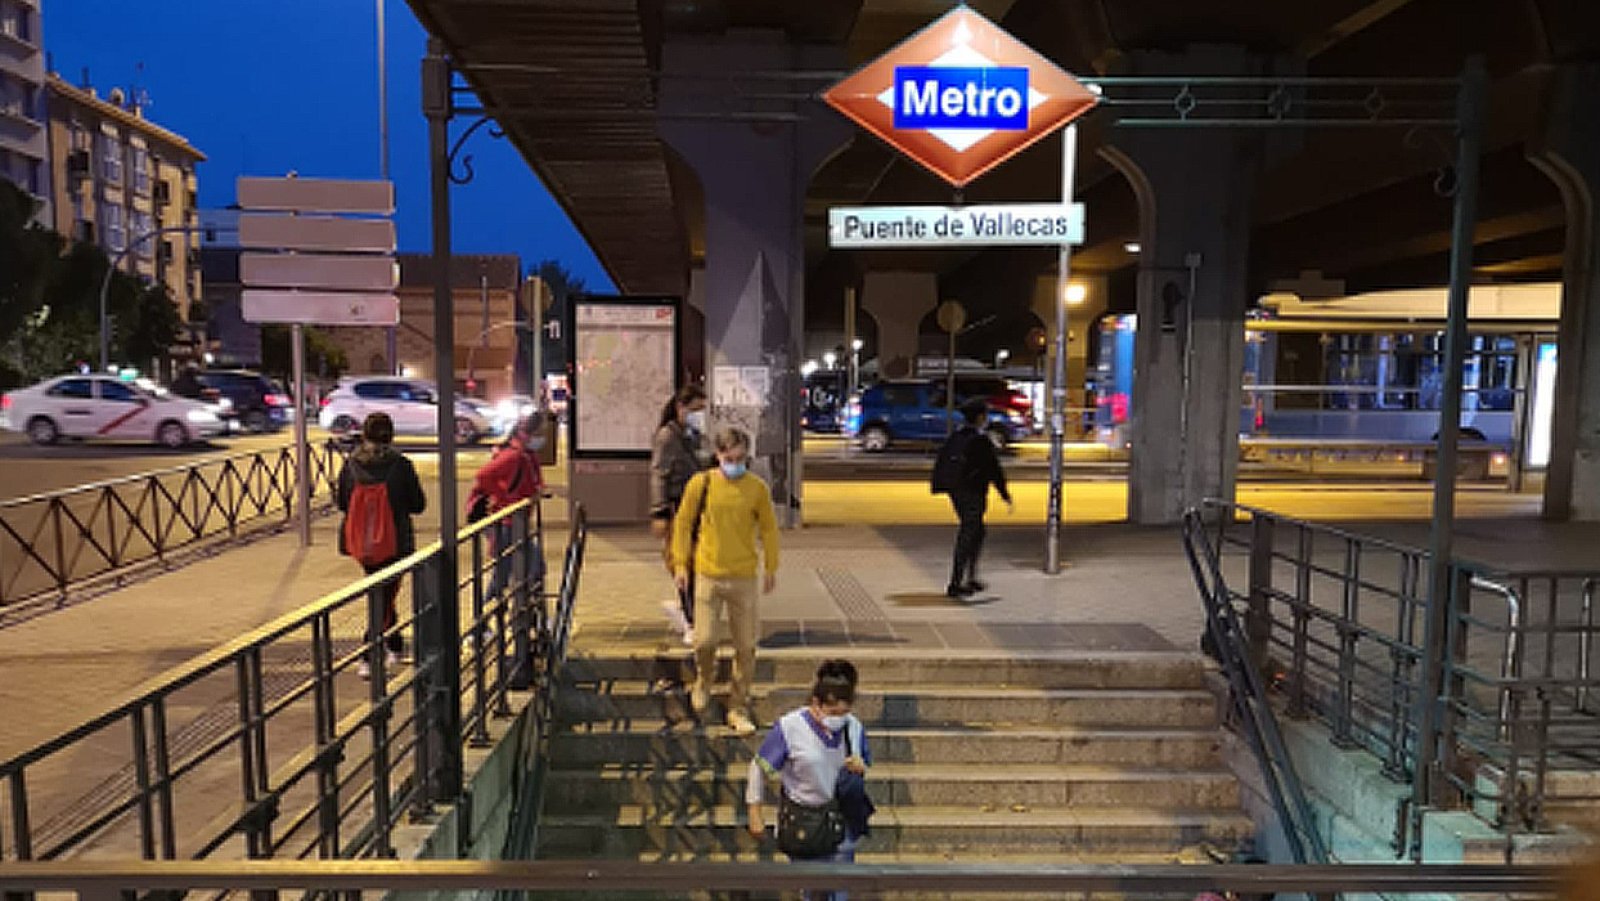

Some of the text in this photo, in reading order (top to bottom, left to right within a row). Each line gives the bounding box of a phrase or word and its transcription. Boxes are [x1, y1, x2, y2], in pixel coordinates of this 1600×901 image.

[903, 80, 1021, 117] Metro
[844, 211, 1067, 239] Puente de Vallecas
